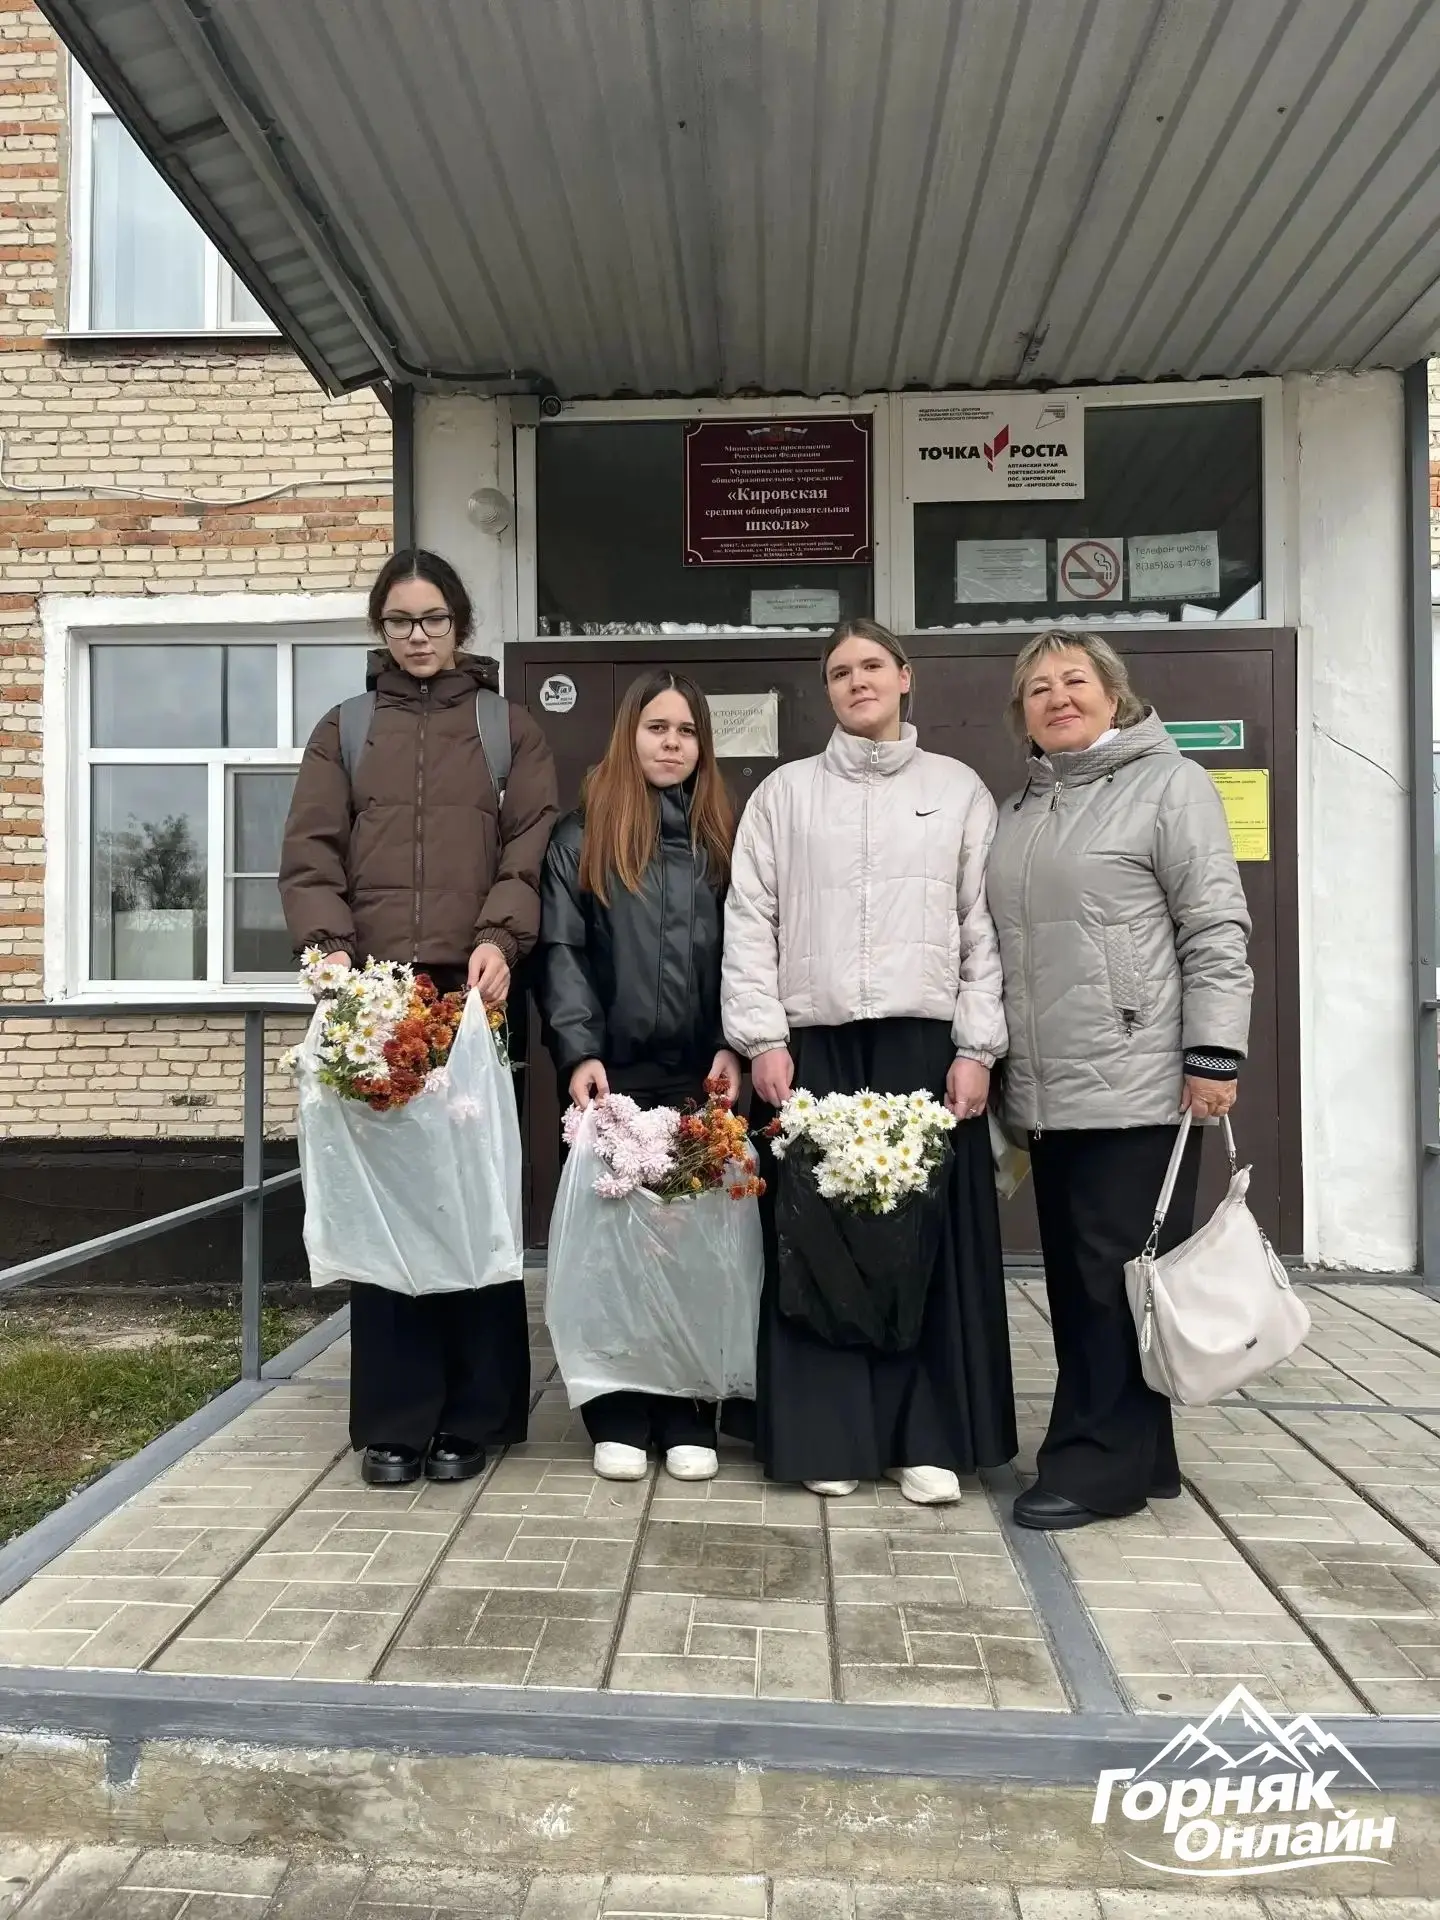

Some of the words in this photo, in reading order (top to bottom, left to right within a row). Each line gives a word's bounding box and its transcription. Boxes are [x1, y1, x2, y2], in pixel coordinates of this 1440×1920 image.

[724, 445, 779, 453] Министерство
[918, 446, 981, 460] ТОЧКА
[1009, 444, 1068, 458] РОСТА
[779, 451, 821, 459] Федерации
[729, 468, 793, 476] Муниципальное
[711, 476, 795, 484] общеобразовательное
[796, 475, 844, 483] учреждение
[727, 487, 828, 504] «Кировская
[705, 507, 743, 518] средняя
[745, 505, 850, 516] общеобразовательная
[745, 519, 810, 531] школа»
[1135, 546, 1174, 556] Телефон
